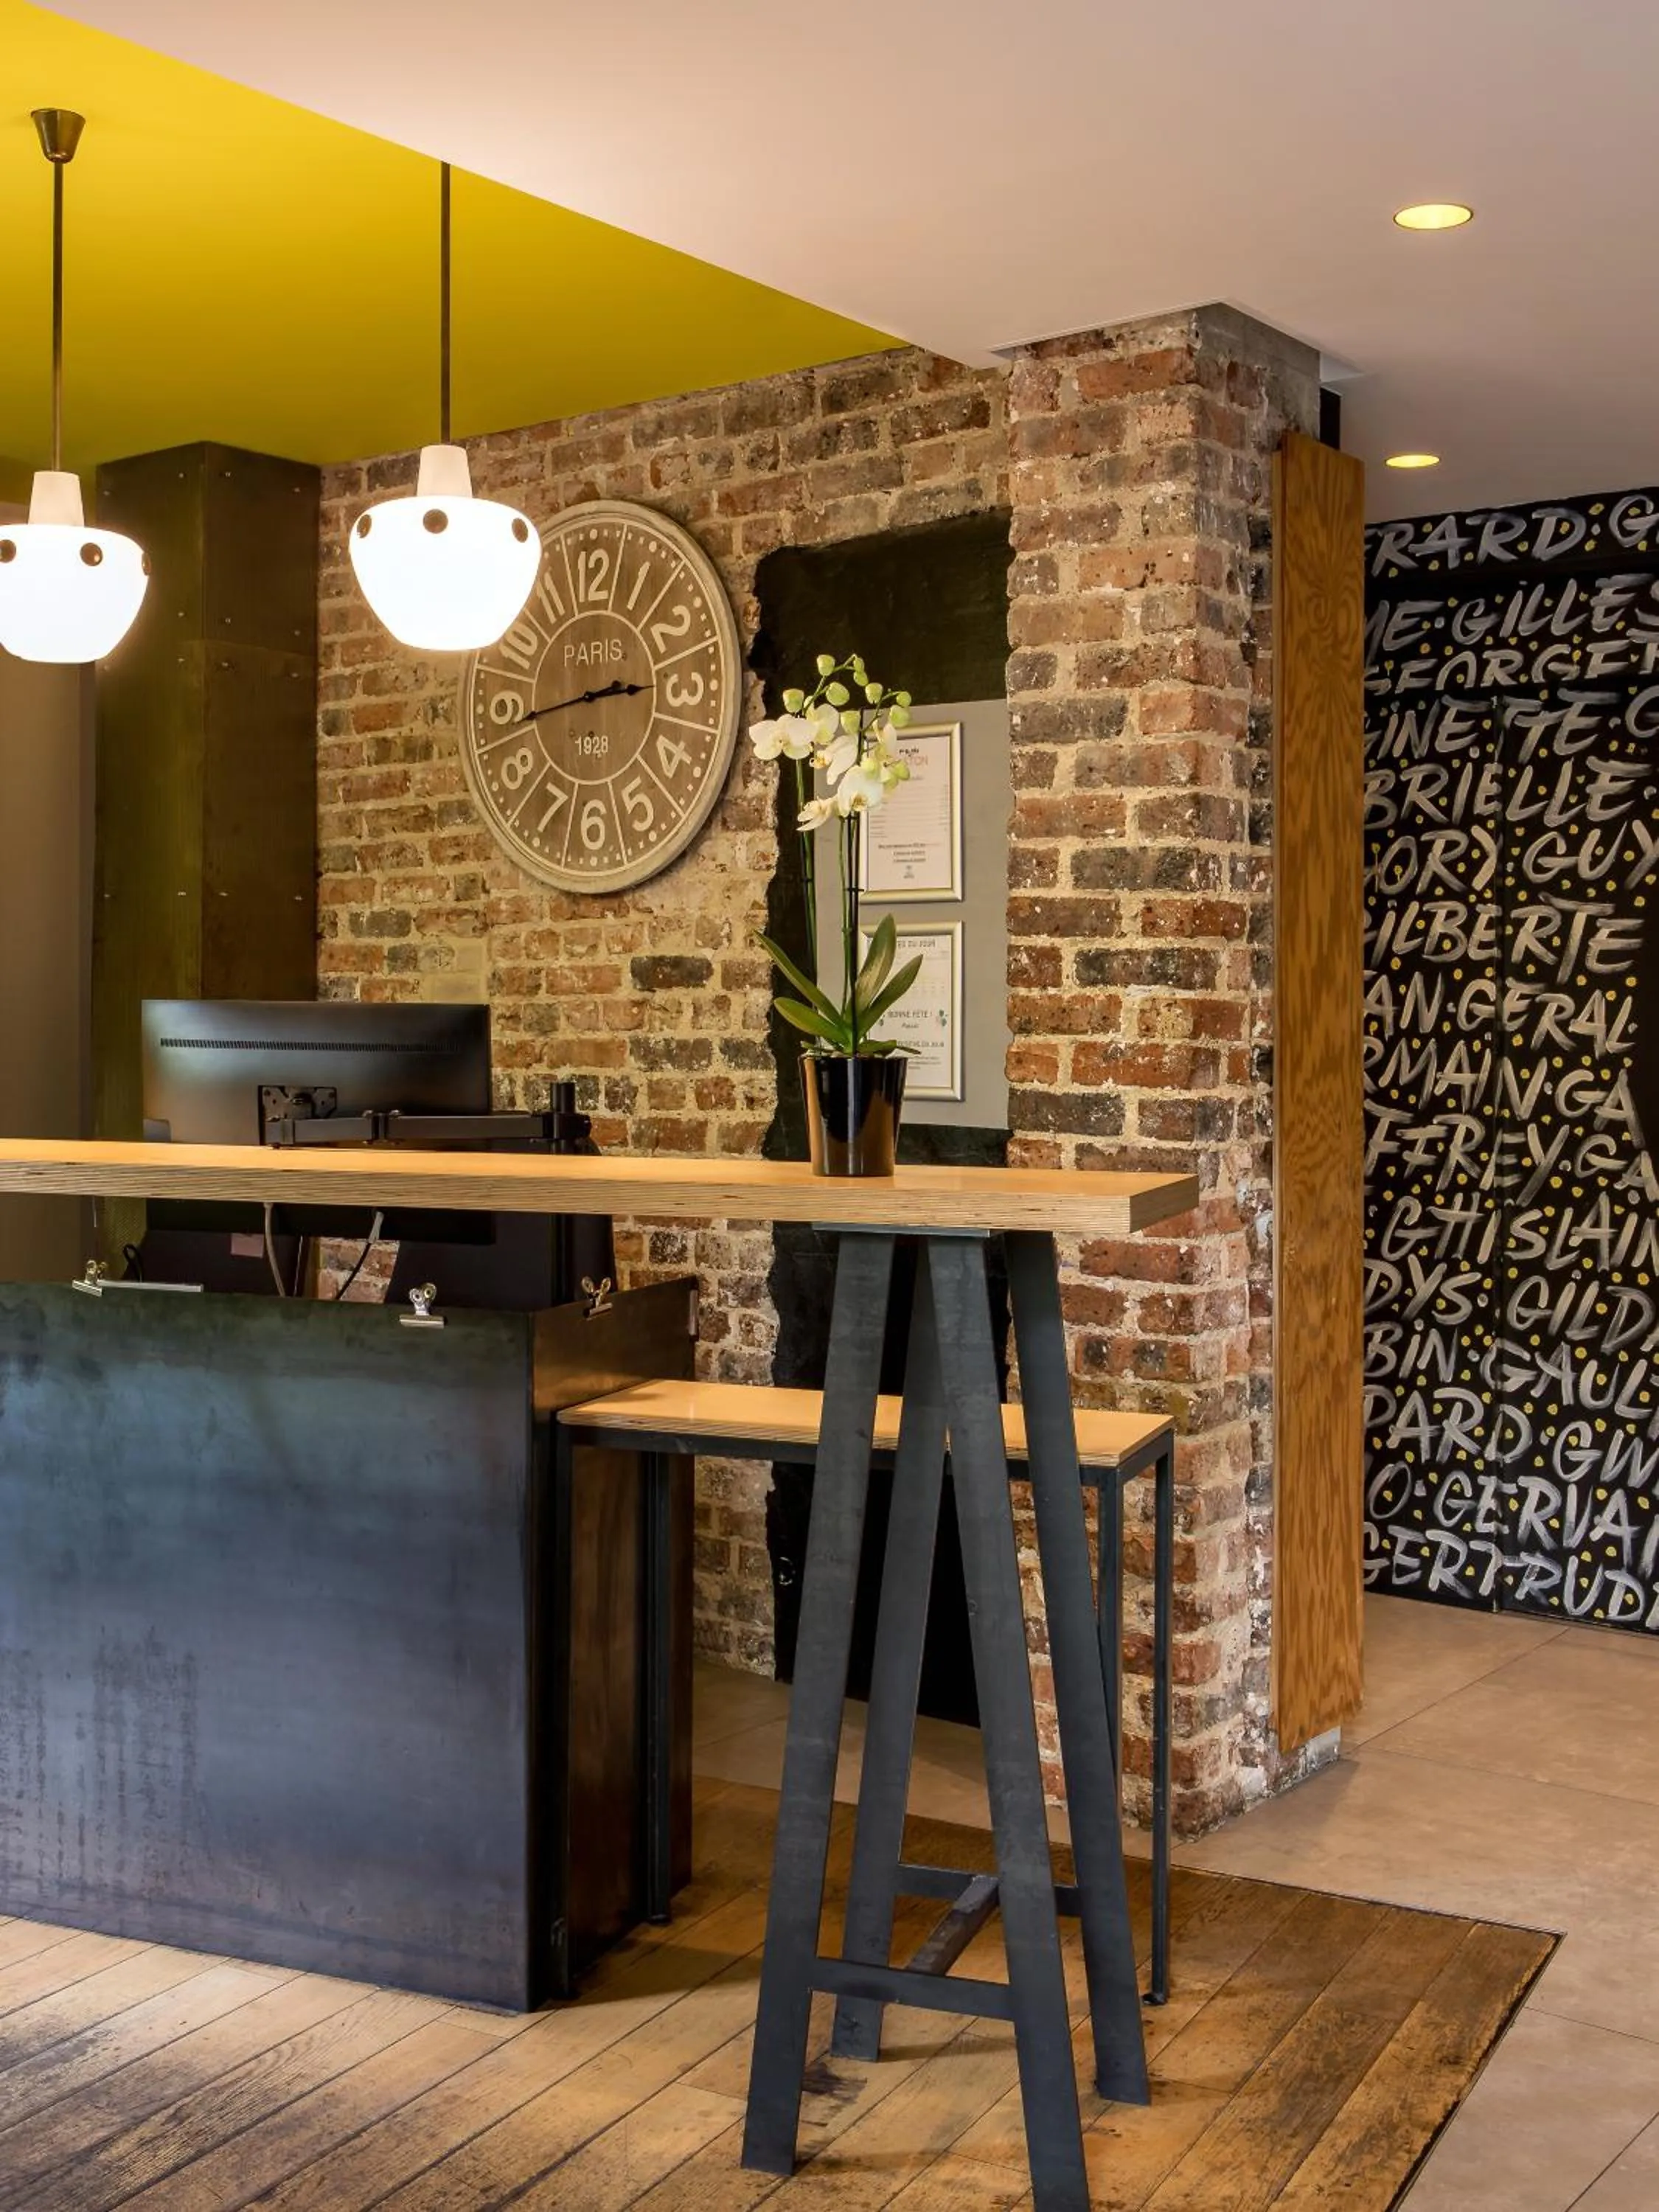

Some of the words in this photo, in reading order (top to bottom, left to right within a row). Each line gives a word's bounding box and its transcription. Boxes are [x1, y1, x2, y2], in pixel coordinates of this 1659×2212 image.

[536, 568, 566, 624] 11
[578, 549, 609, 602] 12
[627, 561, 650, 611] 1
[499, 622, 538, 669] 10
[563, 639, 622, 667] PARIS
[650, 605, 691, 654] 2
[490, 690, 524, 725] 9
[666, 672, 703, 707] 3
[501, 747, 533, 790] 8
[574, 735, 608, 755] 1928
[656, 734, 692, 778] 4
[538, 782, 568, 832] 7
[580, 799, 606, 850] 6
[622, 776, 655, 832] 5
[1522, 819, 1659, 890] GUY
[1364, 892, 1645, 985] ILBERTE
[1363, 970, 1444, 1040] AN
[1507, 1274, 1659, 1354] GILD
